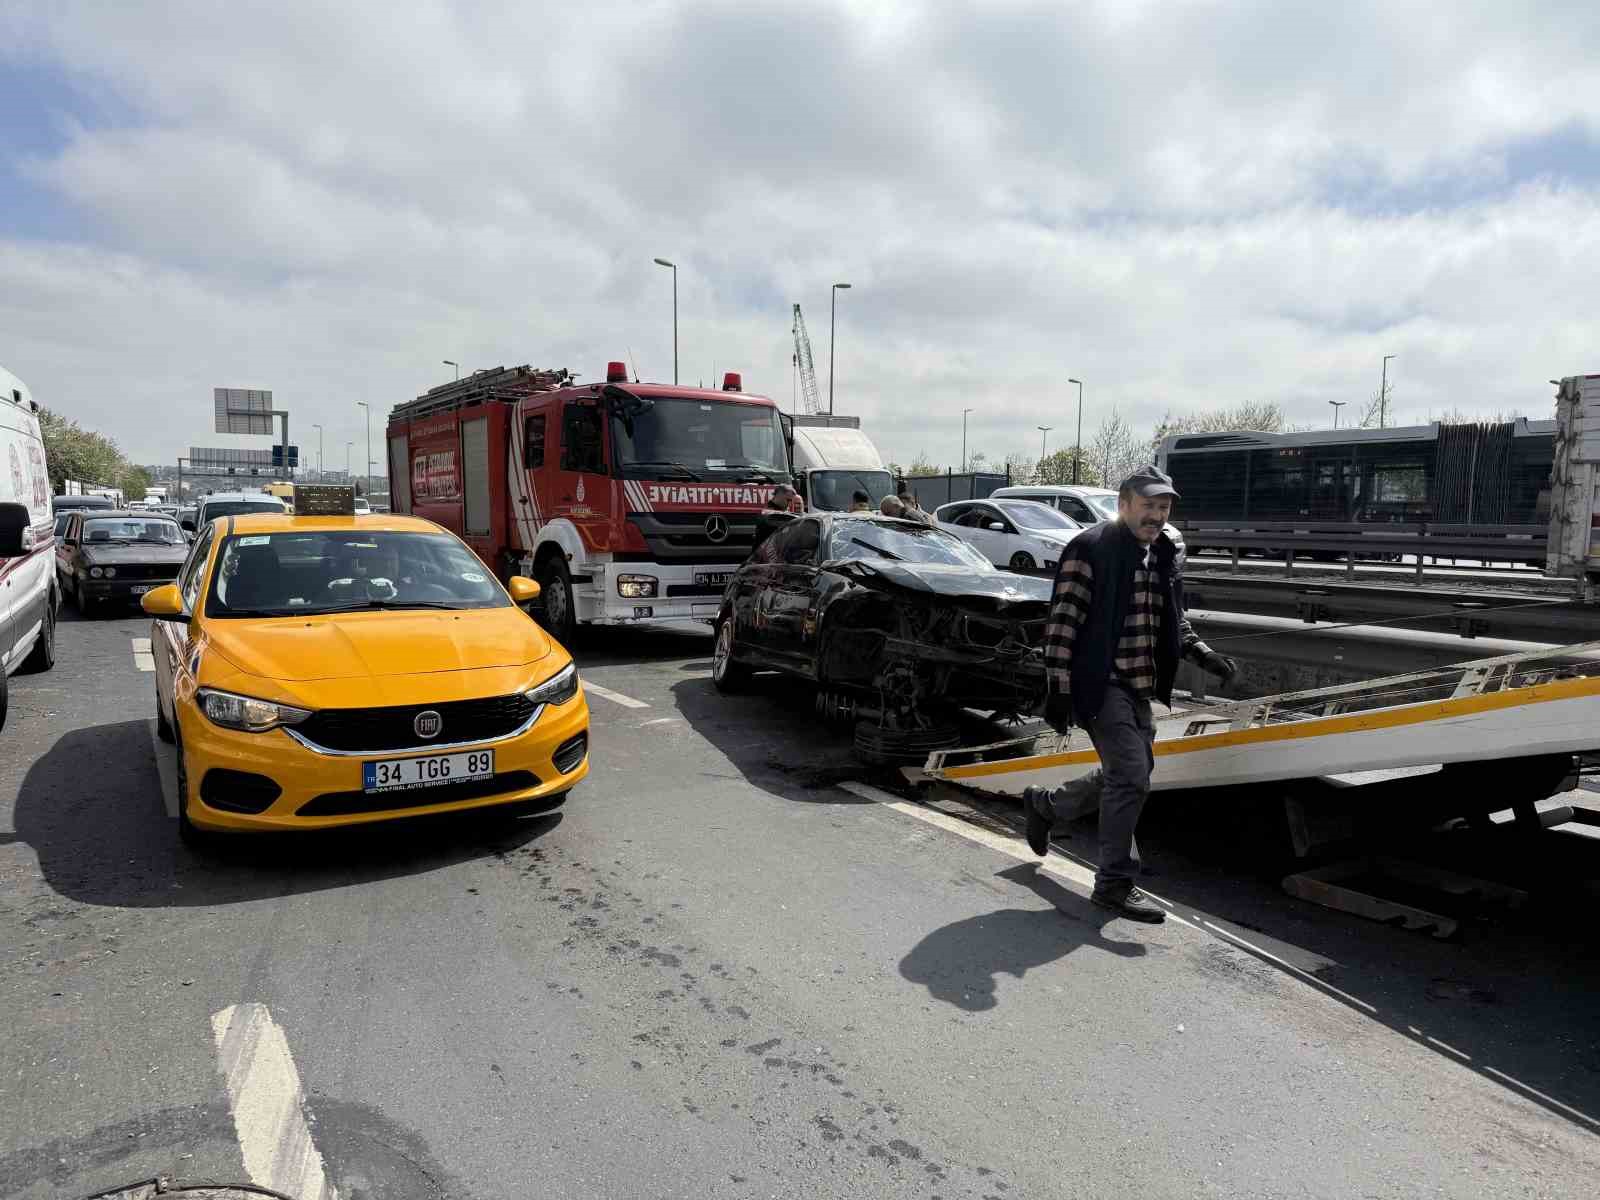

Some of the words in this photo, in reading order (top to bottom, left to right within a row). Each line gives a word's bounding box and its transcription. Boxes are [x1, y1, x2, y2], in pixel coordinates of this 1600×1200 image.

[420, 718, 437, 731] FIAT
[378, 763, 402, 784] 34
[415, 758, 450, 780] TGG
[468, 753, 490, 773] 89
